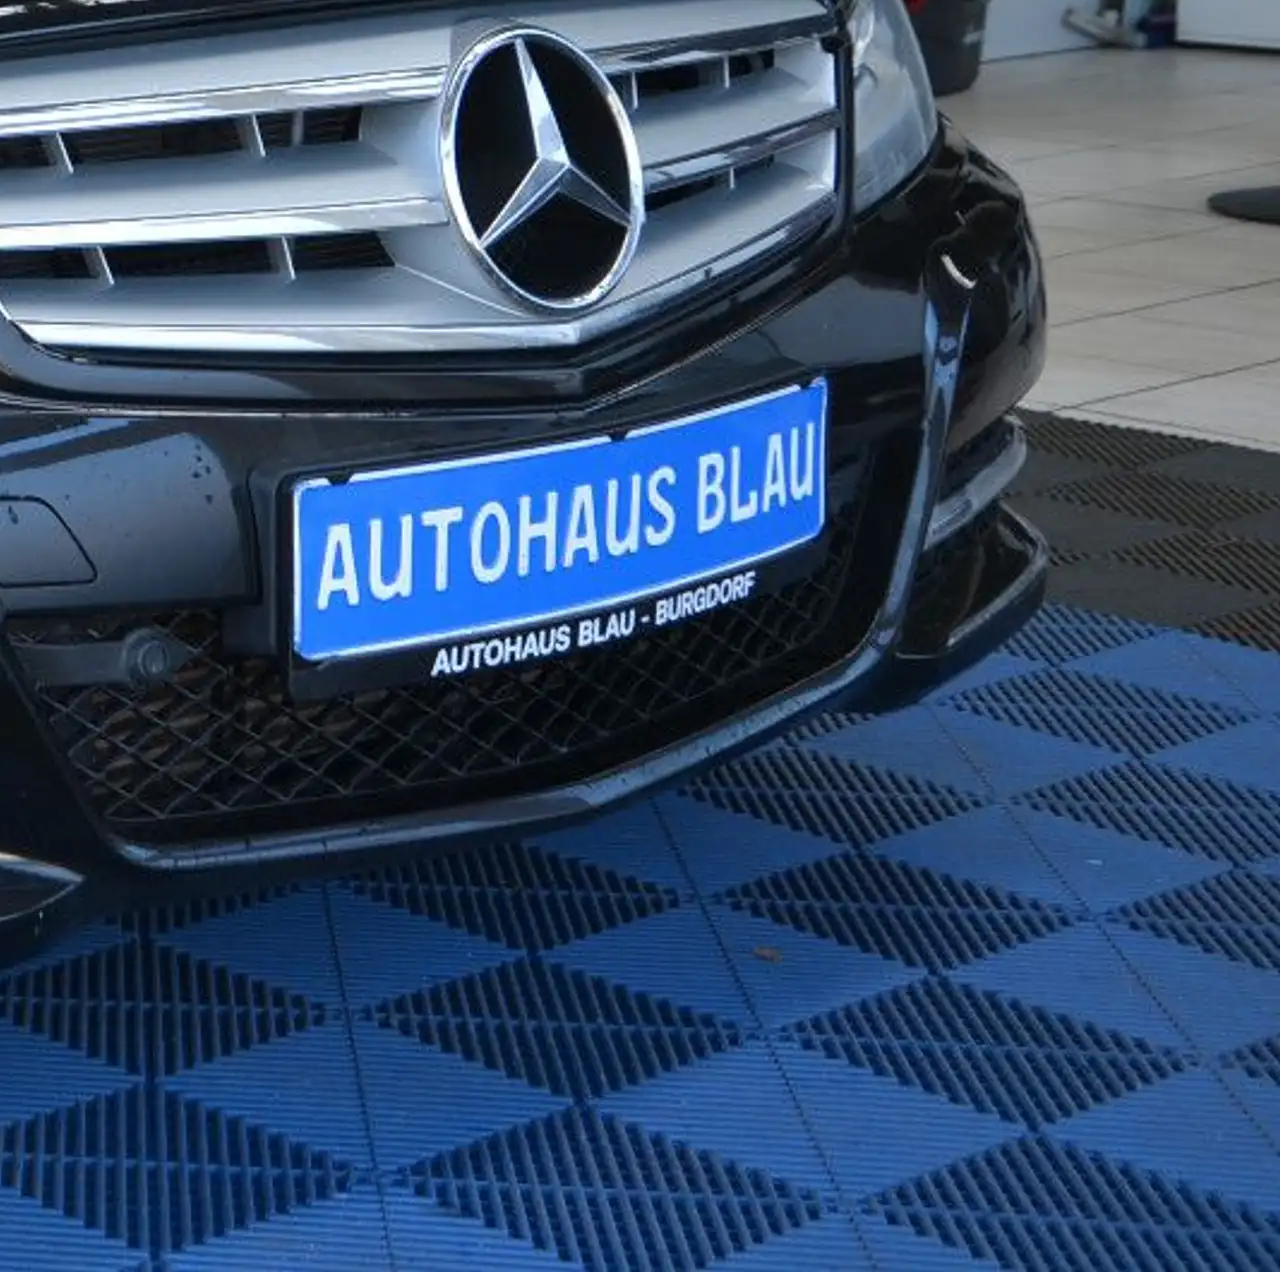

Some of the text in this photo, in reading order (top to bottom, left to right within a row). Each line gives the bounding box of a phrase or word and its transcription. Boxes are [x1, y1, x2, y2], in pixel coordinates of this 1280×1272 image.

[316, 422, 815, 611] AUTOHAUS BLAU
[430, 624, 571, 677] AUTOHAUS
[577, 609, 636, 647] BLAU
[654, 570, 757, 626] BURGDORF
